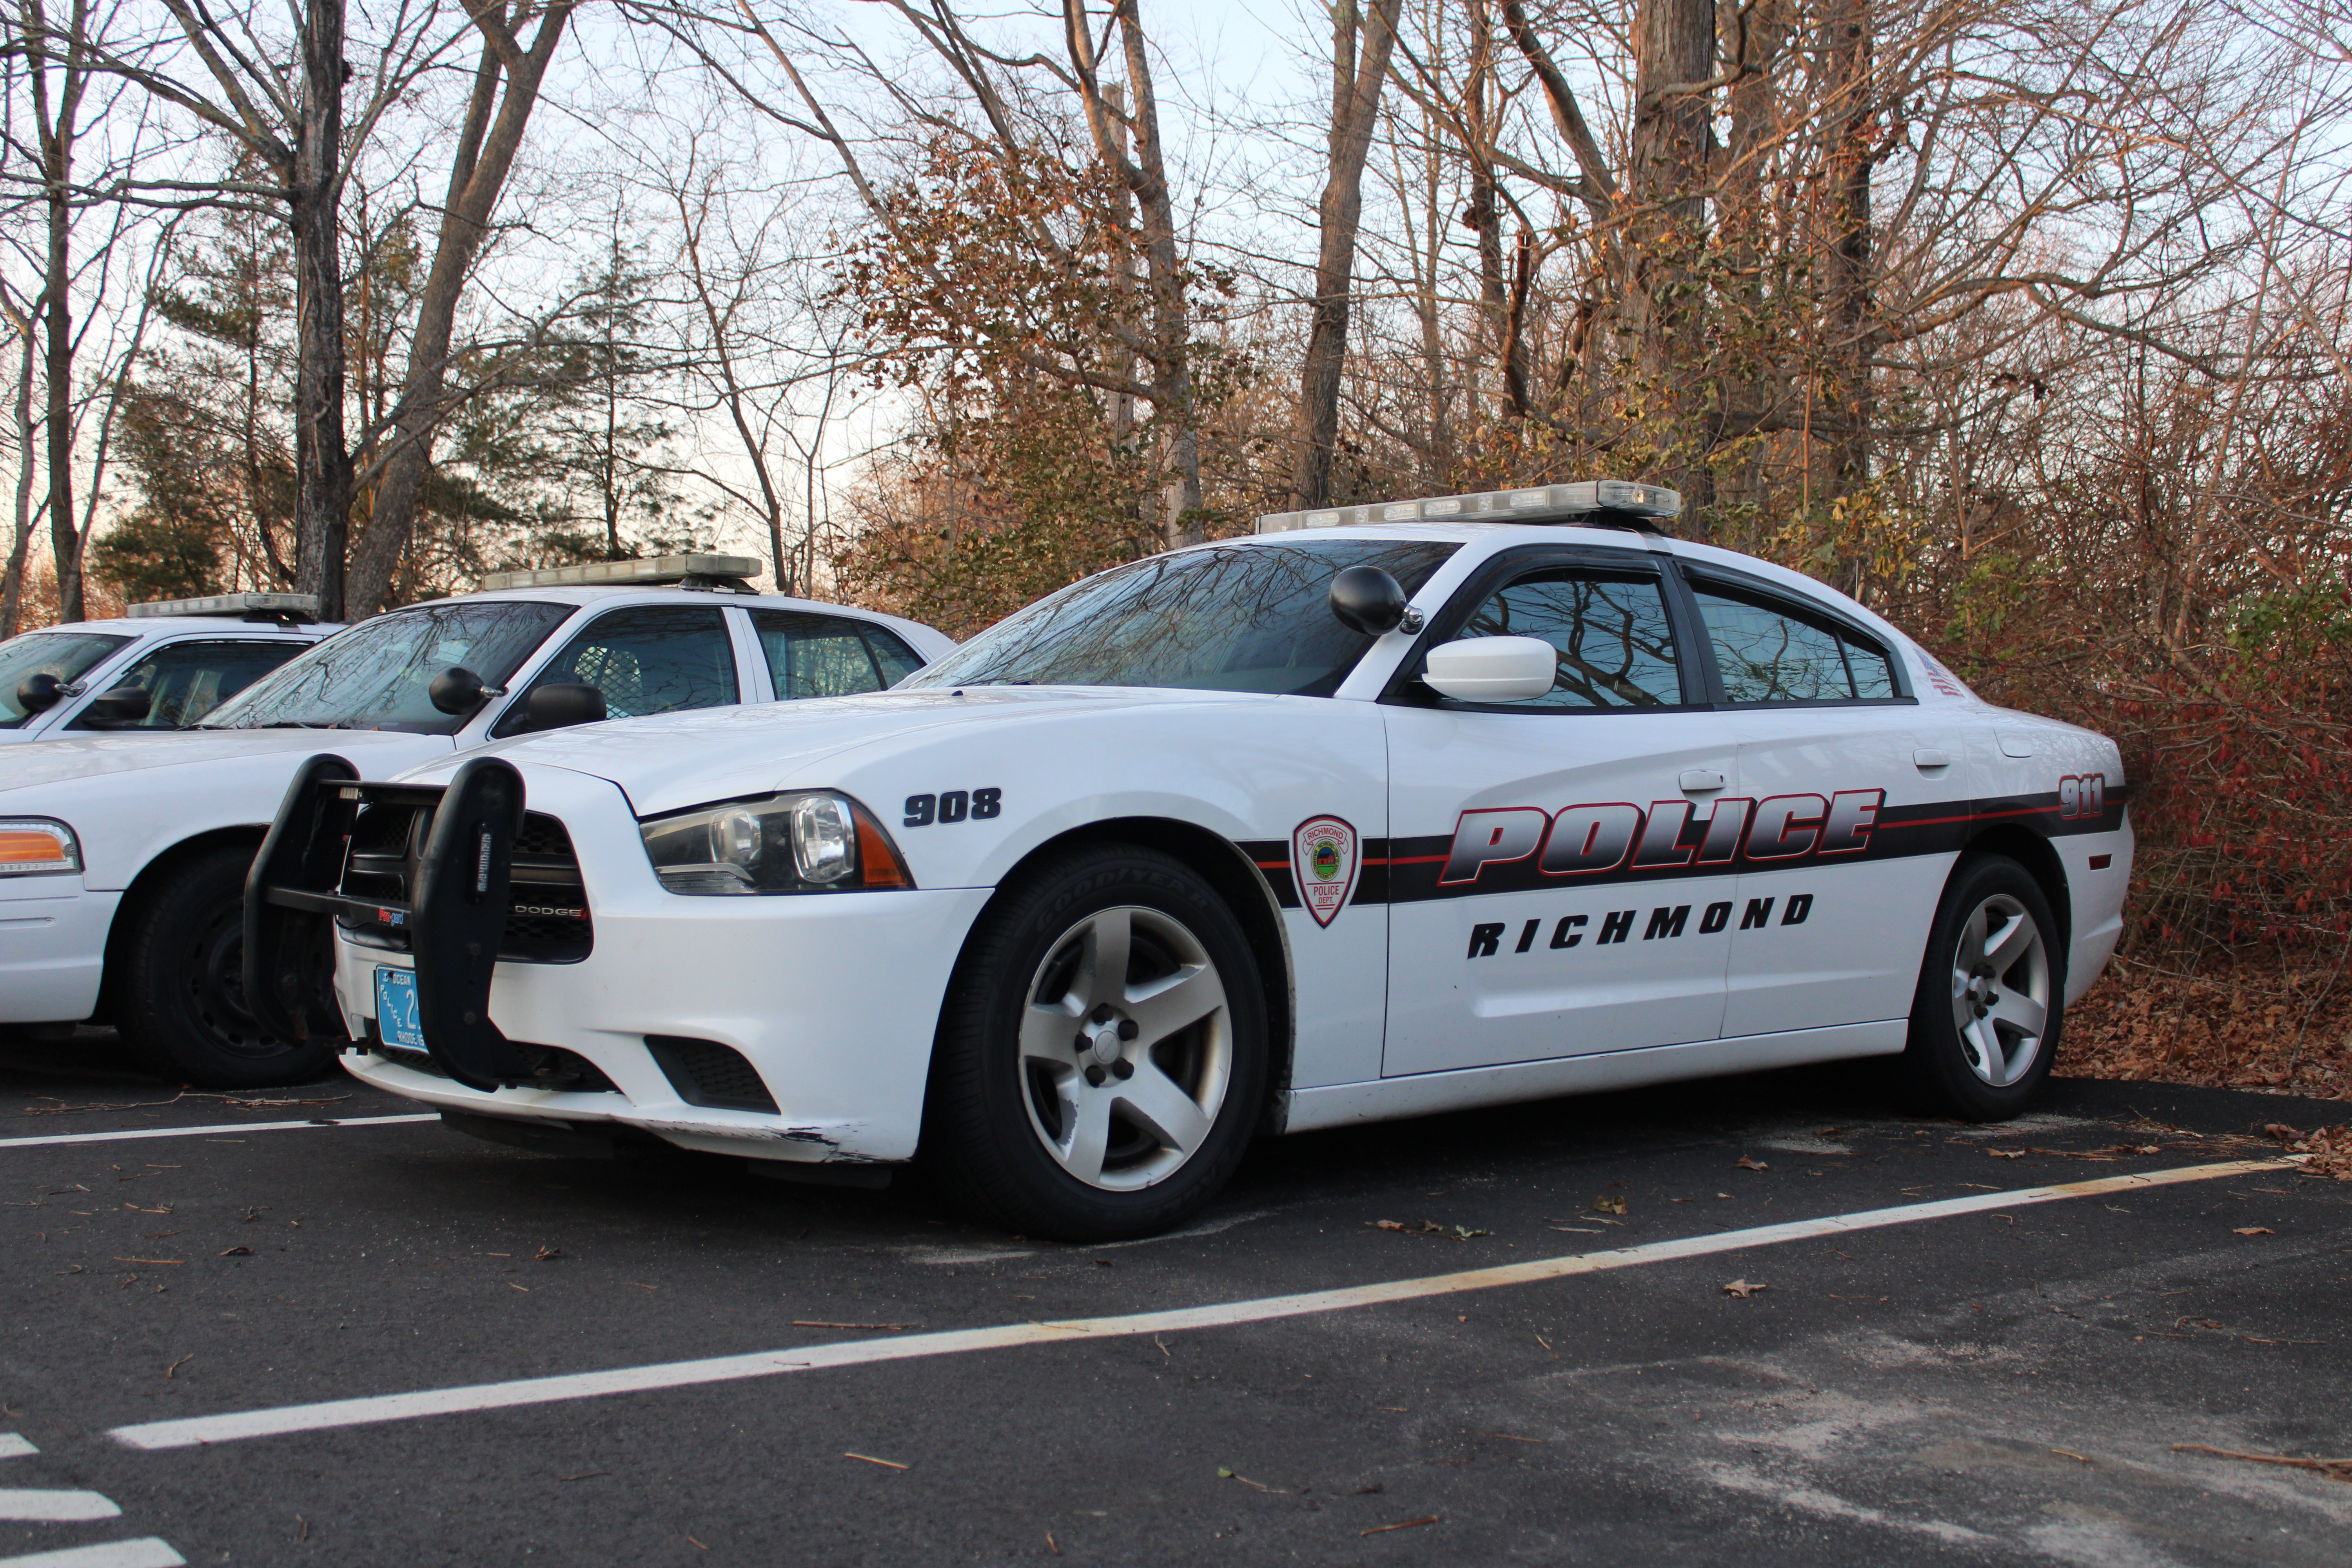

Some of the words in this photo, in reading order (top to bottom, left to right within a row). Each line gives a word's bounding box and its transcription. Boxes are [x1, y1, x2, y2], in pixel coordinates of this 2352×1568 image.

[903, 787, 1002, 828] 908
[2059, 773, 2105, 820] 911
[1307, 828, 1343, 840] RICHMOND
[1437, 788, 1885, 887] POLICE
[515, 906, 581, 916] DODGE
[1037, 867, 1208, 933] GOODYEAR
[1314, 886, 1339, 896] POLICE
[1467, 894, 1814, 960] RICHMOND
[393, 973, 411, 986] OCEAN
[379, 984, 403, 1028] POLICE
[406, 989, 421, 1030] 2
[397, 1031, 417, 1045] RHODE
